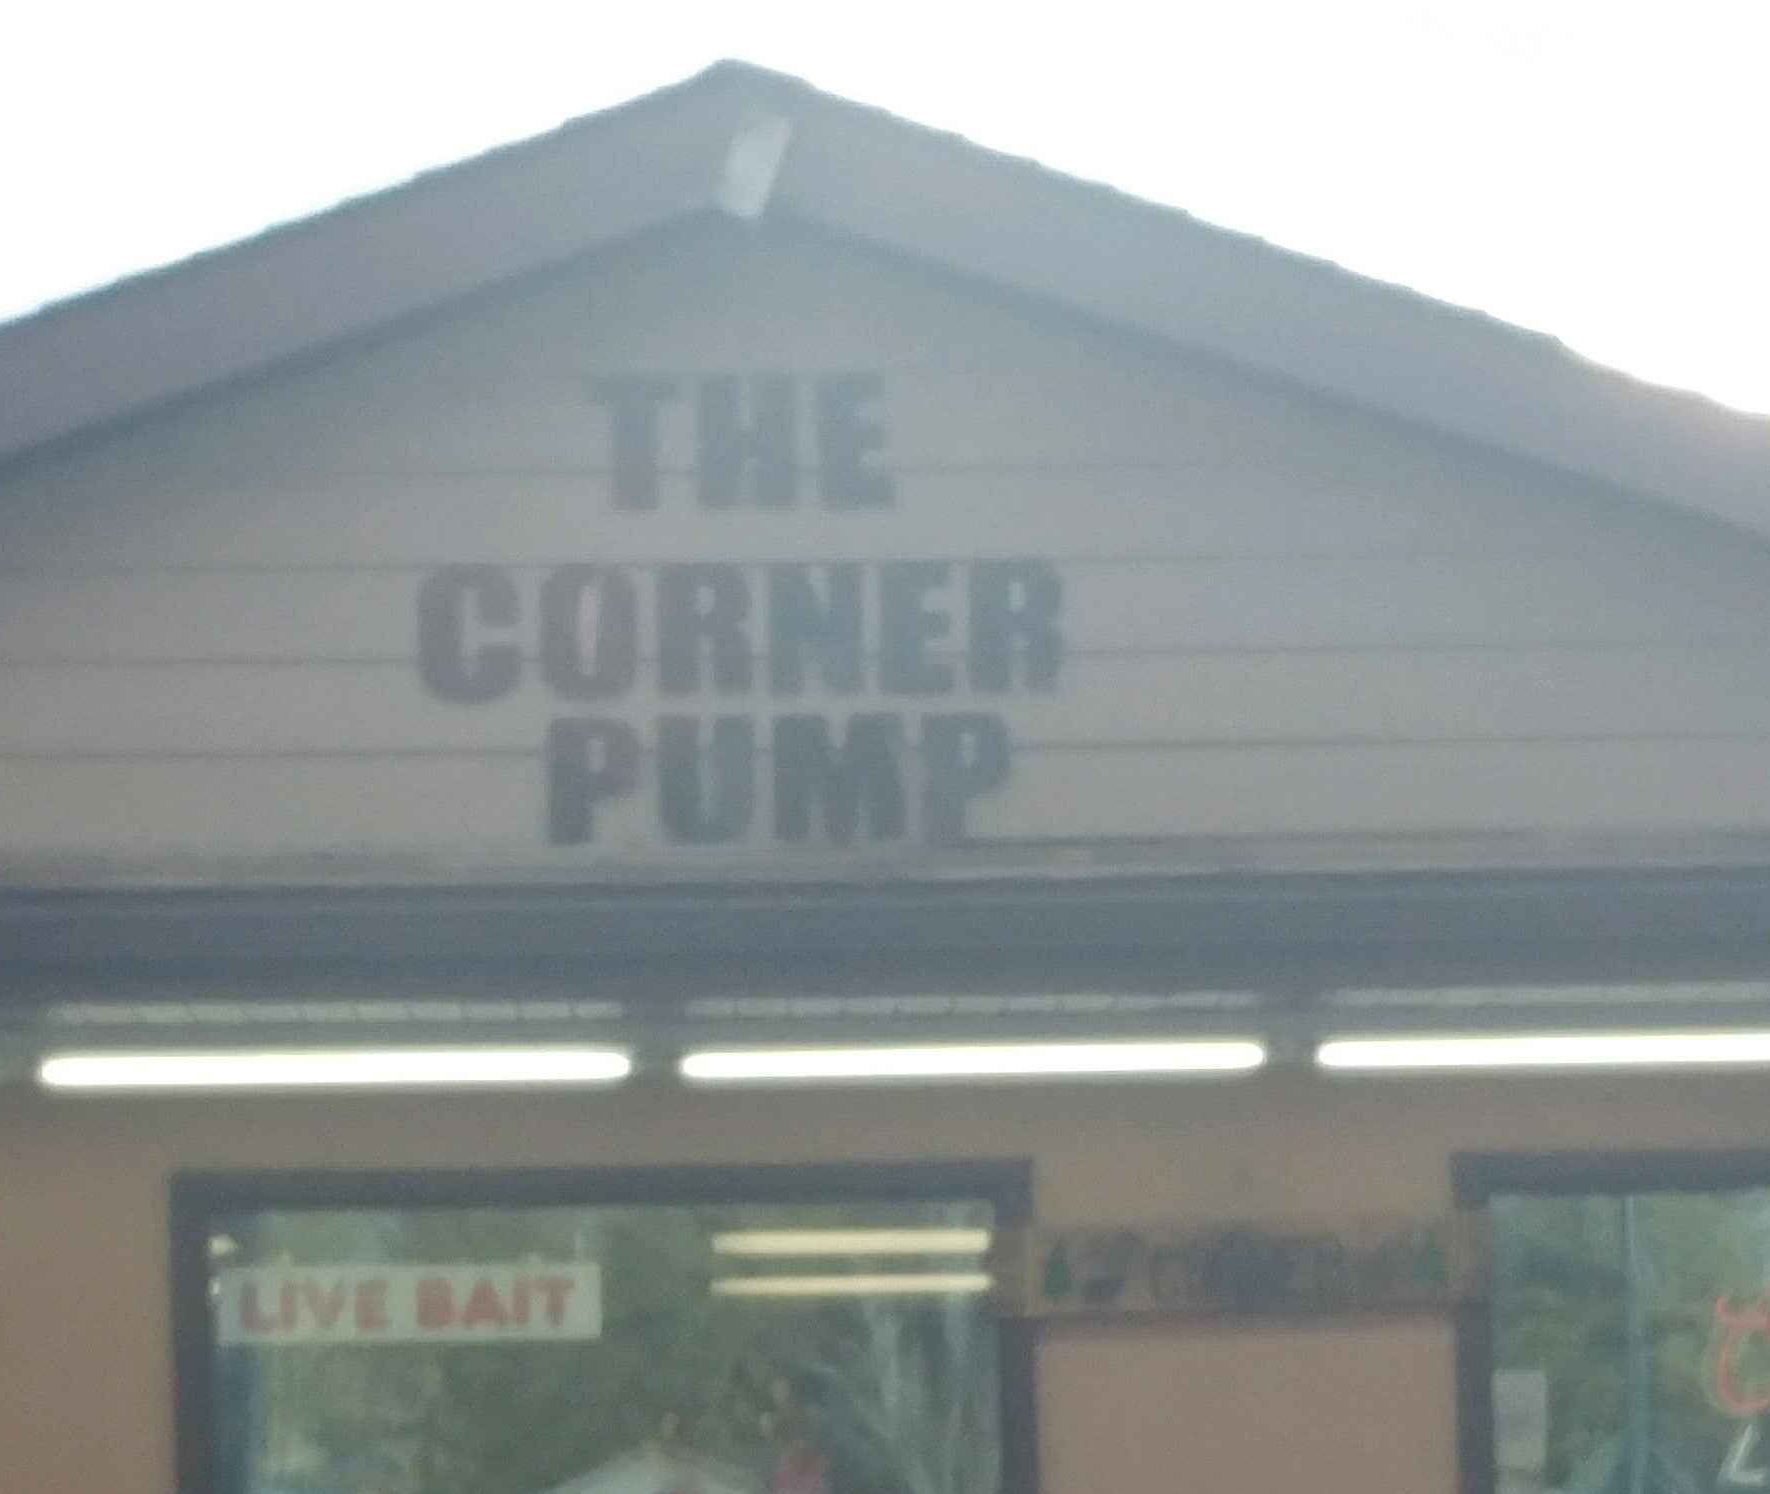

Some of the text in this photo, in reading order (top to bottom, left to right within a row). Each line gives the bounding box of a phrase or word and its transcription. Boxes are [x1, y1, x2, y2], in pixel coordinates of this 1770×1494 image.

[587, 370, 897, 512] THE
[417, 557, 1065, 704] CORNER
[547, 713, 1013, 846] PUMP
[239, 1277, 577, 1332] LIVE BAIT
